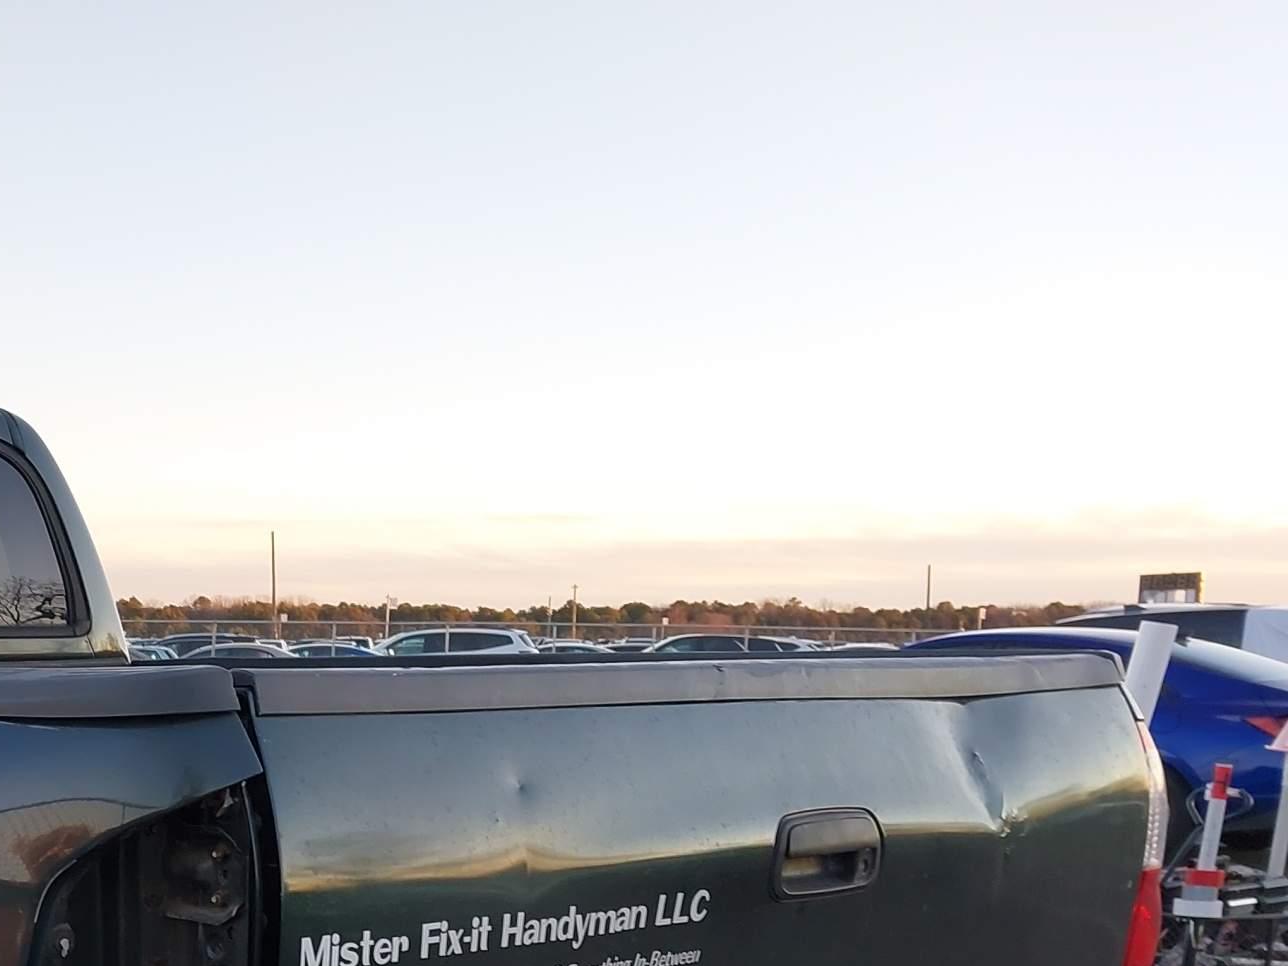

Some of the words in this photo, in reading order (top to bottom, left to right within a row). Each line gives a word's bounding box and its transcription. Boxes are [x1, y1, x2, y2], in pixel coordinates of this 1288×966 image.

[420, 916, 492, 959] Fix-it
[500, 905, 648, 950] Handyman
[654, 889, 710, 926] LLC
